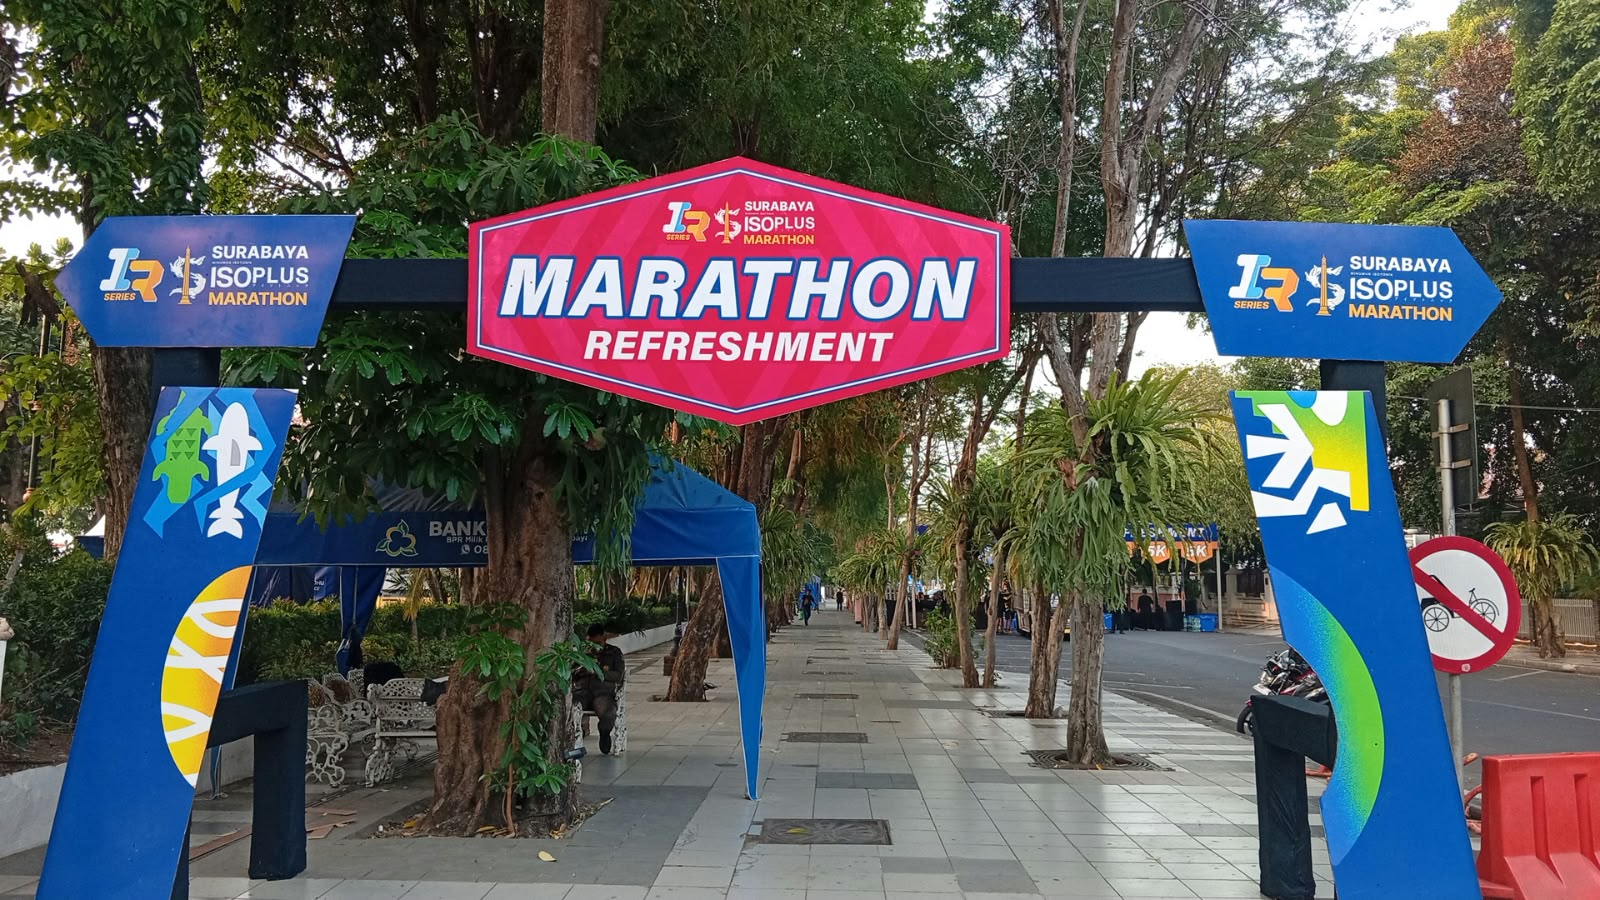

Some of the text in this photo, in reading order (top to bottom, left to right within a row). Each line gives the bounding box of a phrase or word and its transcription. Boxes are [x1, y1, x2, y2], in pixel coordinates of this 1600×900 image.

[744, 201, 815, 212] SURABAYA
[744, 216, 816, 232] ISOPLUS
[666, 233, 691, 241] SERIES
[743, 234, 815, 245] MARATHON
[211, 245, 309, 260] SURABAYA
[1349, 256, 1453, 274] SURABAYA
[210, 266, 309, 288] ISOPLUS
[103, 292, 136, 301] SERIES
[499, 256, 977, 321] MARATHON
[1349, 277, 1454, 301] ISOPLUS
[208, 291, 308, 306] MARATHON
[1233, 300, 1270, 310] SERIES
[1348, 303, 1453, 322] MARATHON
[583, 330, 893, 363] REFRESHMENT
[429, 520, 486, 537] BANK
